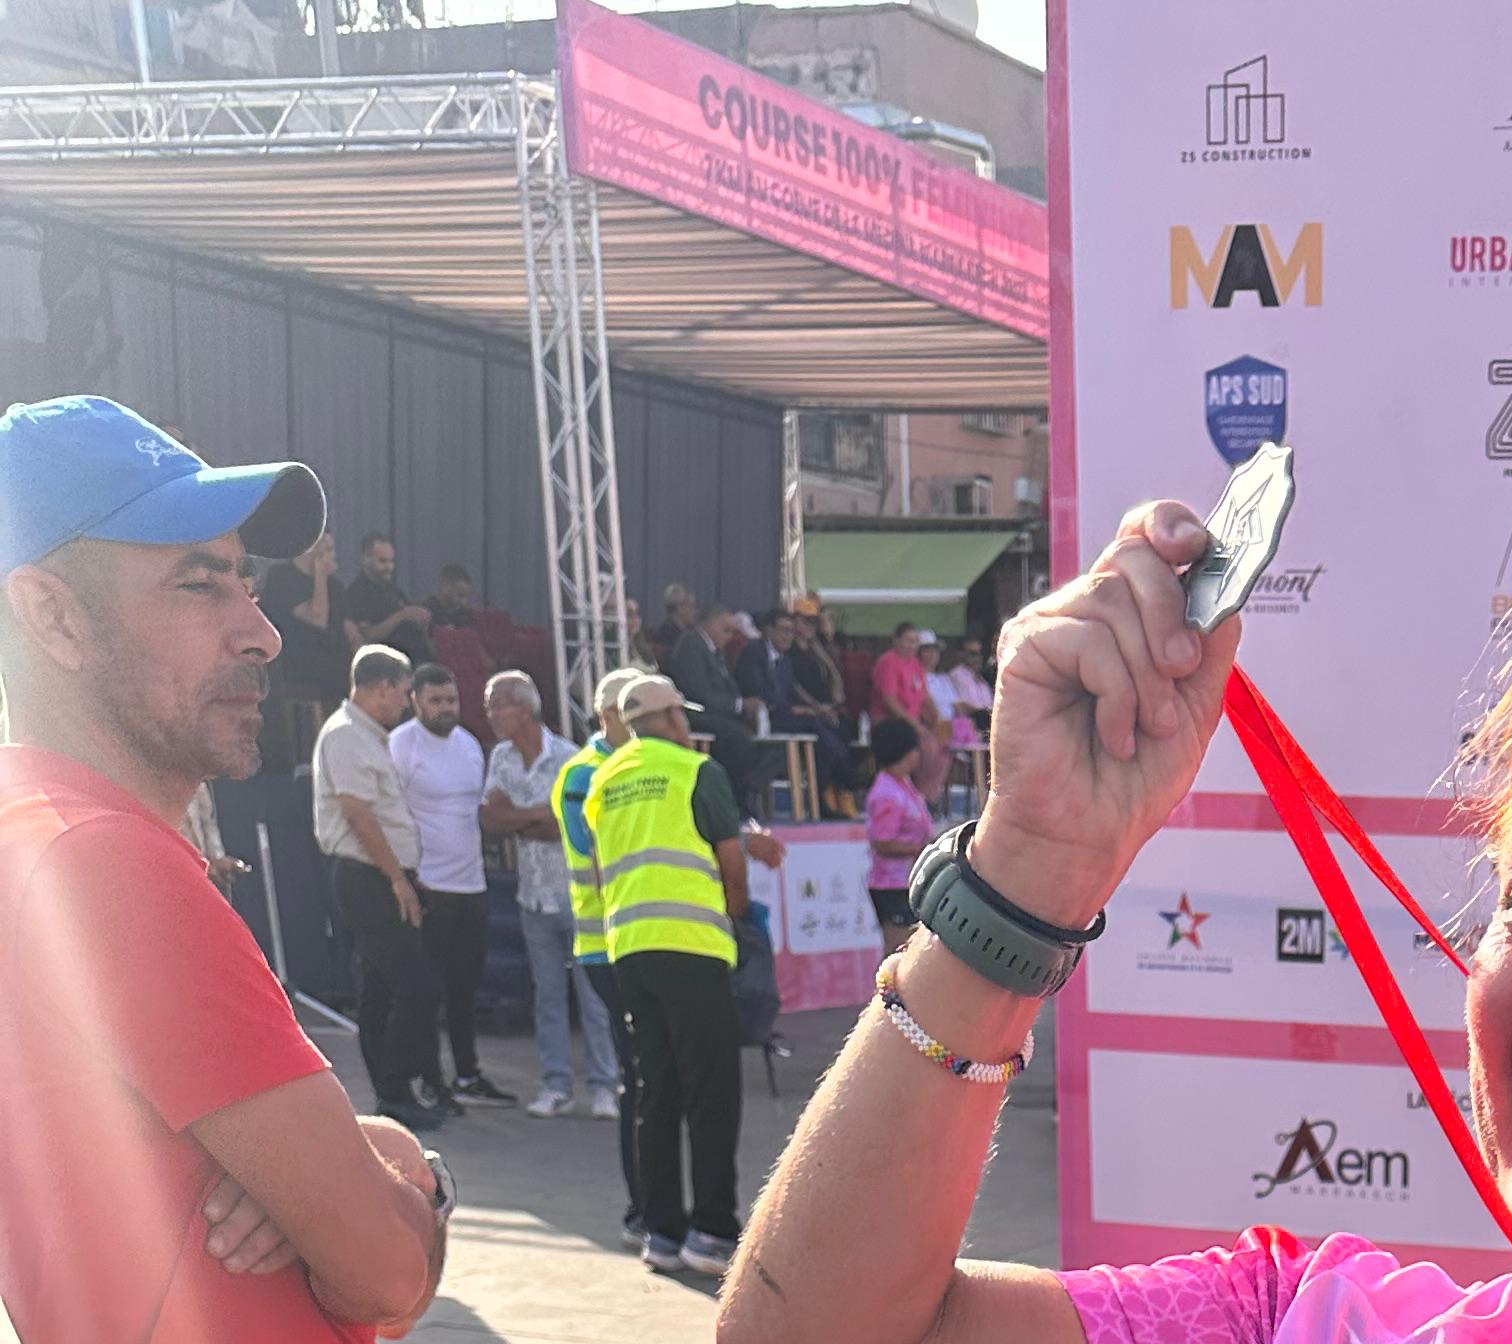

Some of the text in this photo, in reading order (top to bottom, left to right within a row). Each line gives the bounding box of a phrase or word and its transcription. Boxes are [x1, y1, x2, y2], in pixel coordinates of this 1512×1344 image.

[699, 74, 828, 176] COURSE
[832, 131, 906, 209] 100%
[1201, 147, 1312, 162] CONSTRUCTION
[1170, 222, 1323, 309] MAM
[1209, 374, 1285, 406] APS SUD
[1280, 917, 1322, 956] 2M
[1252, 1117, 1409, 1198] Aem
